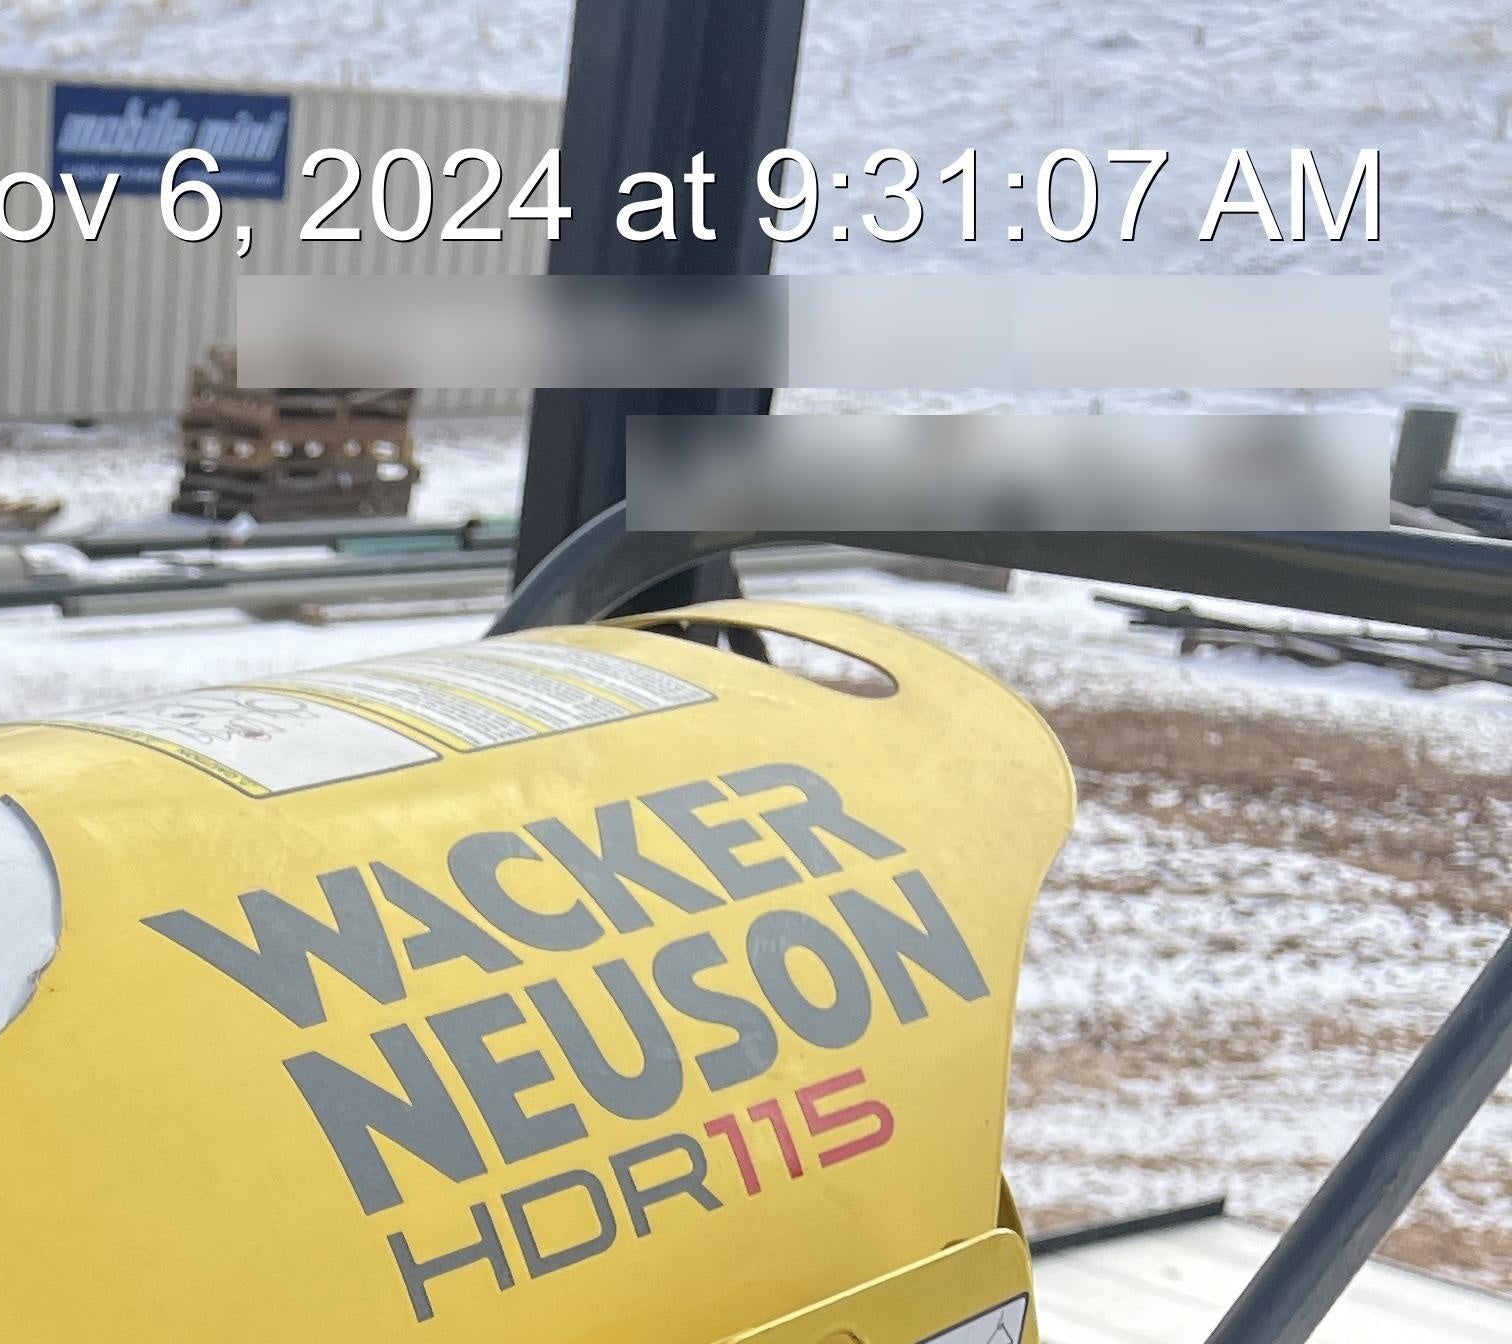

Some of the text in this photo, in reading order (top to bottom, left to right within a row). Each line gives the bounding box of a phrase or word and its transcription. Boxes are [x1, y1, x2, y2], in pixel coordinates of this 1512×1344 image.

[139, 761, 907, 1029] WACKER
[282, 869, 991, 1217] NEUSON
[386, 1067, 896, 1324] HDR115
